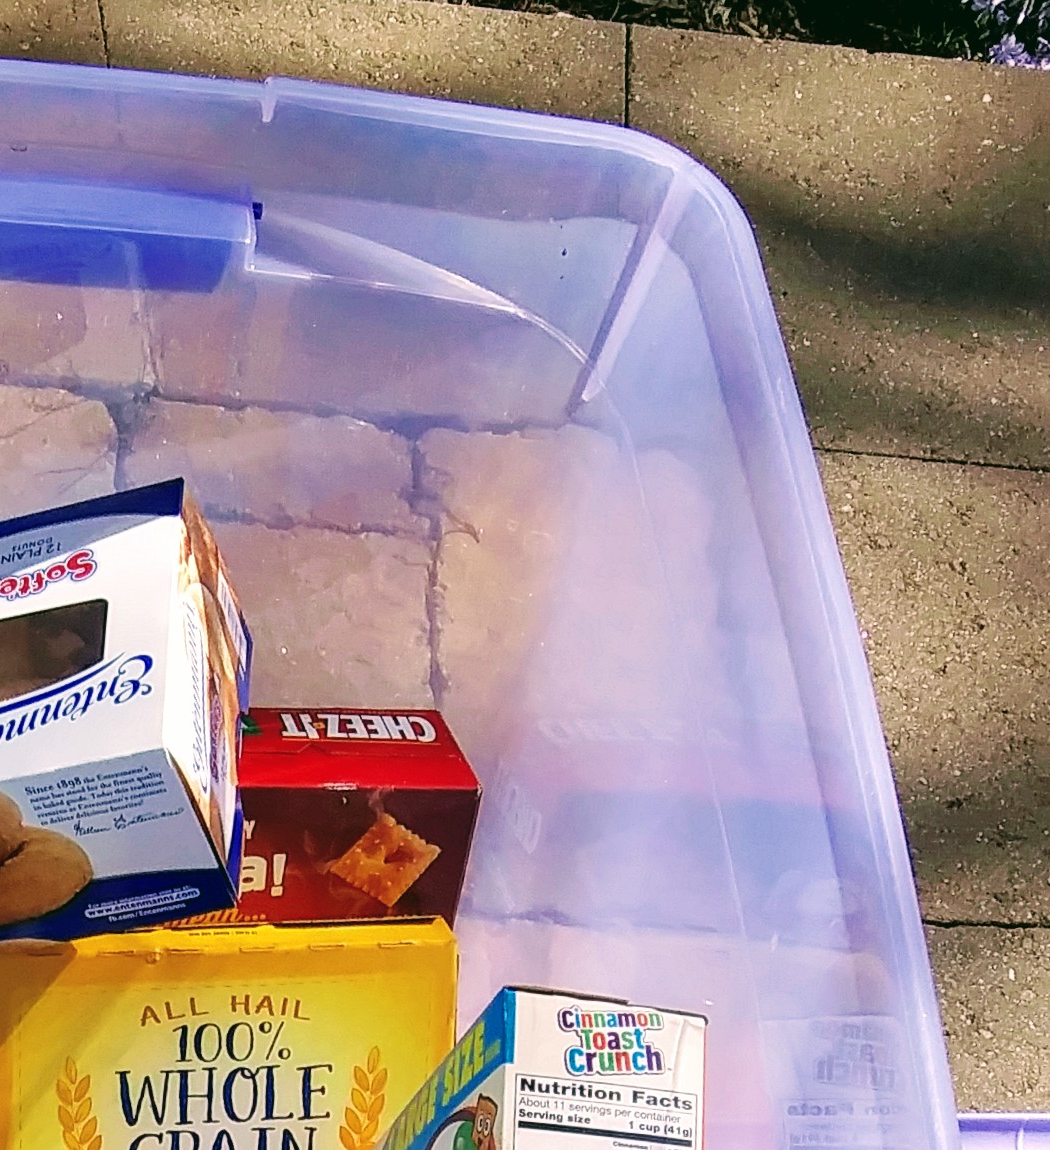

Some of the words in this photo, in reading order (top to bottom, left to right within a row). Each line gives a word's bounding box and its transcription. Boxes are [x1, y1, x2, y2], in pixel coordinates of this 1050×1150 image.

[12, 537, 53, 552] DONUTS
[50, 541, 62, 554] 12
[1, 548, 42, 564] PLAIN
[25, 785, 53, 795] Since
[57, 777, 81, 791] 1898
[137, 772, 162, 784] quality
[140, 997, 209, 1027] ALL
[231, 994, 311, 1021] HAIL
[560, 1008, 662, 1029] Cinnamon
[173, 1021, 291, 1063] 100%
[580, 1029, 645, 1050] Toast
[442, 1020, 485, 1107] SIZE
[568, 1045, 663, 1073] Crunch
[115, 1064, 332, 1127] WHOLE
[520, 1077, 621, 1101] Nutrition
[632, 1090, 693, 1110] Facts
[519, 1097, 550, 1108] About
[569, 1103, 612, 1116] servings
[614, 1108, 632, 1119] per
[635, 1110, 681, 1124] container
[519, 1108, 563, 1123] Serving
[567, 1114, 591, 1124] size
[628, 1121, 633, 1129] 1
[639, 1123, 660, 1133] cup
[664, 1122, 692, 1137] (41g)
